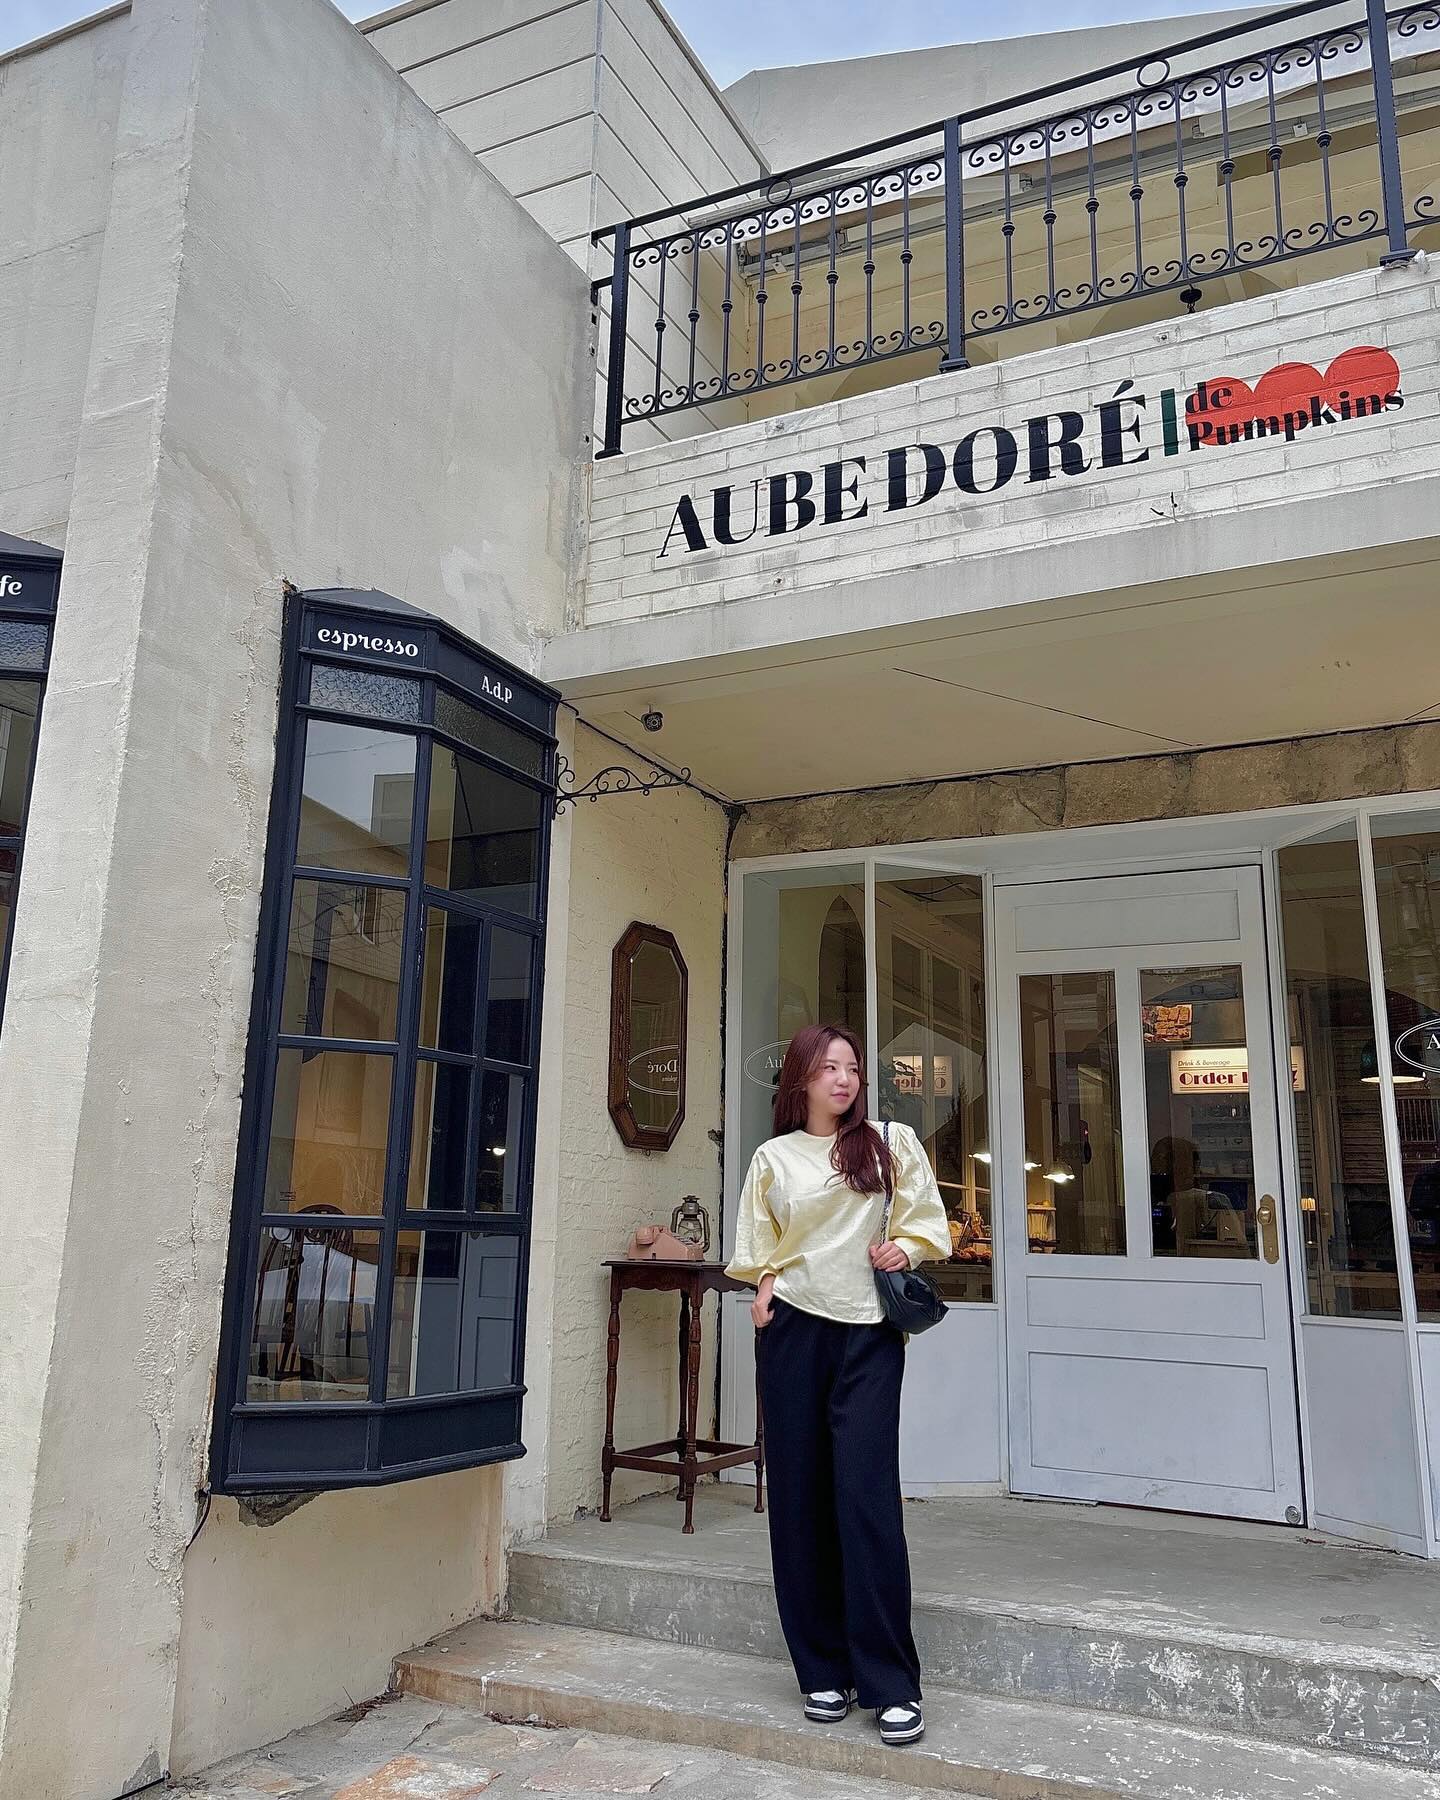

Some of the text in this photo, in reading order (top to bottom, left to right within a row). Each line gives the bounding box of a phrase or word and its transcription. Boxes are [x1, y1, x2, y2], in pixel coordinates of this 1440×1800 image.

[1185, 381, 1232, 414] de
[1185, 388, 1405, 451] Pumpkins
[317, 628, 419, 657] espresso
[481, 675, 513, 704] A.d.P
[1179, 1072, 1238, 1086] Order
